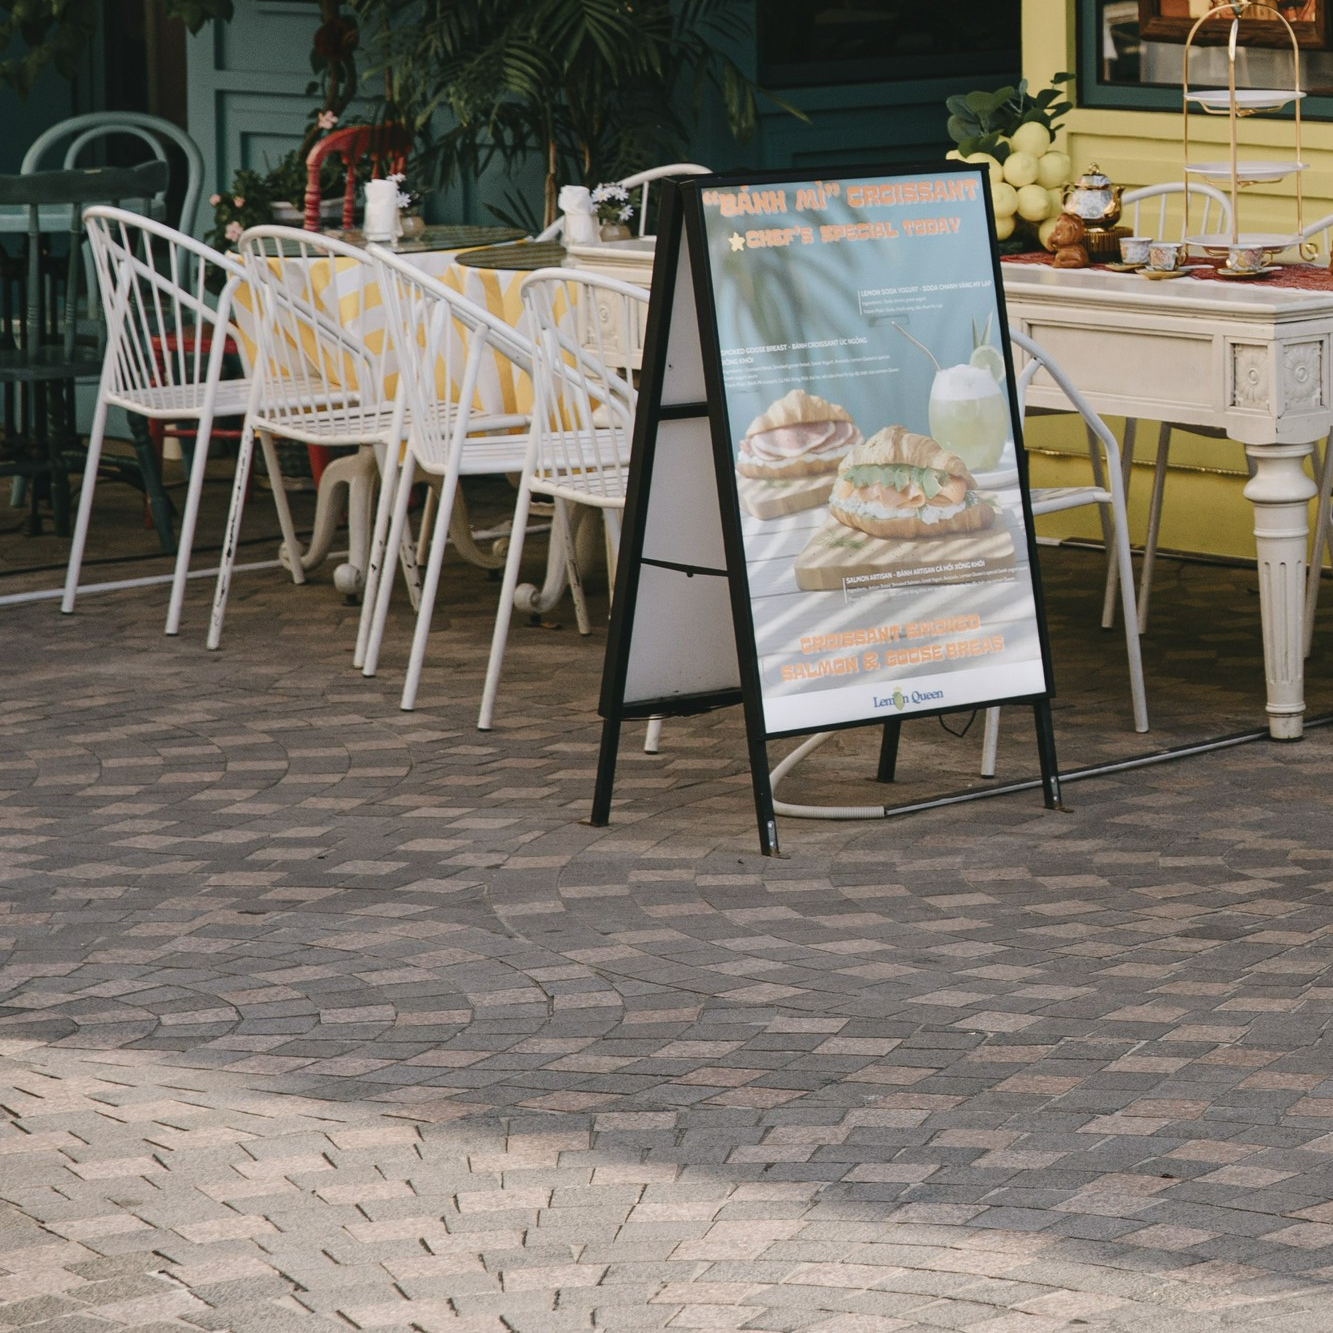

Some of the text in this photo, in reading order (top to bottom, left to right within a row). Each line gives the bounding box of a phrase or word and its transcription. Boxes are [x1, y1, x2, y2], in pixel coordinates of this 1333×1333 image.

[846, 179, 979, 208] CROISSANT
[819, 222, 899, 243] SPECIAL
[902, 217, 961, 237] TODAY
[800, 613, 982, 654] CROISSANT SMOKED
[781, 635, 1005, 683] SALMON & GOOSE BREAS
[912, 689, 944, 705] Queen
